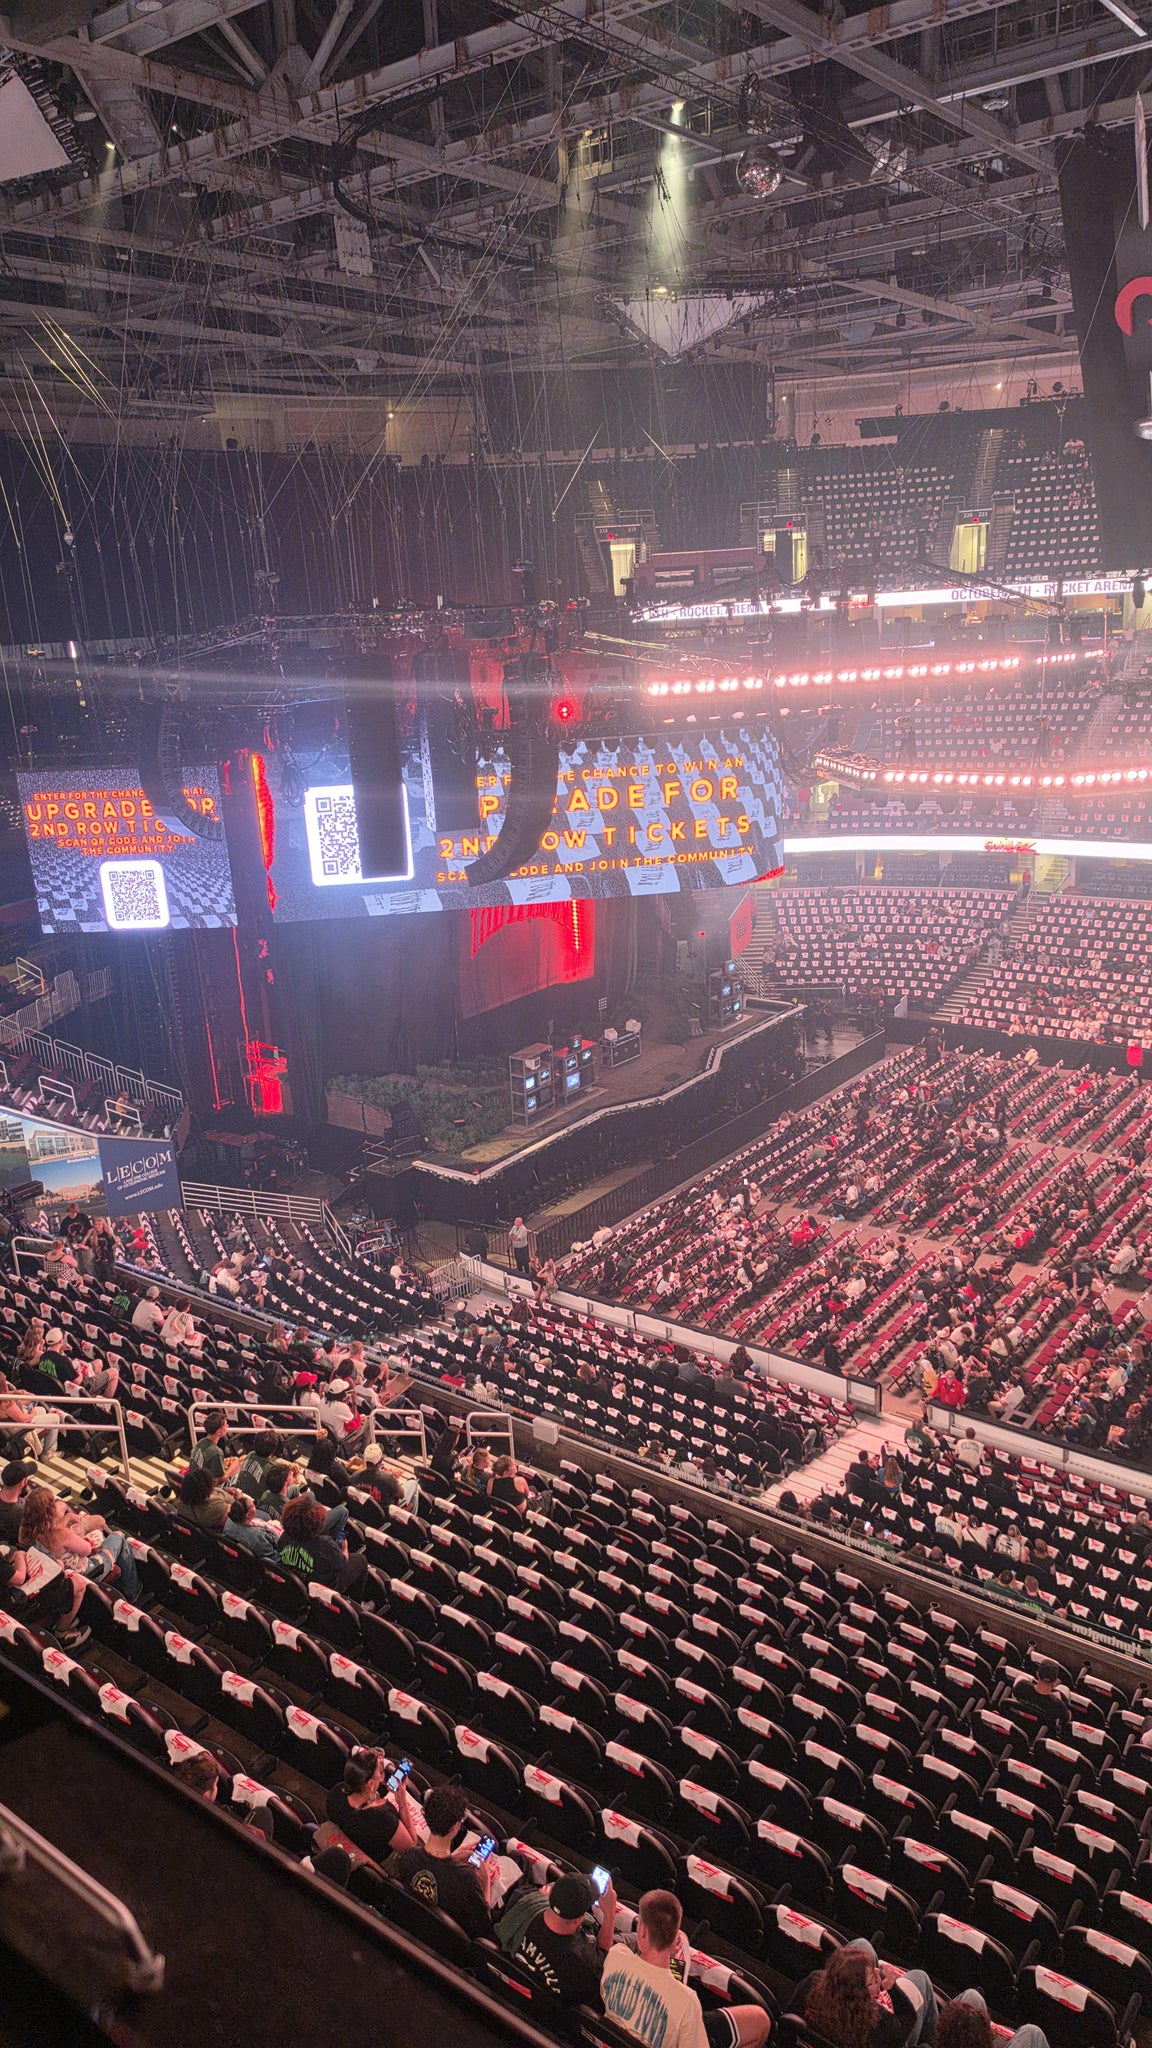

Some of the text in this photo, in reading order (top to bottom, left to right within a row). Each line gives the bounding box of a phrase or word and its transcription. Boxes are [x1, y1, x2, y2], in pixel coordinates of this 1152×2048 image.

[557, 756, 744, 781] HE CHANCE TO WIN AN
[33, 788, 145, 801] ENTER FOR THE CHANC
[663, 776, 739, 805] FOR
[26, 798, 155, 821] UPGRADE
[29, 821, 69, 838] 2ND
[75, 820, 118, 835] ROW
[57, 838, 88, 847] SCAN
[91, 837, 106, 846] QR
[108, 835, 138, 845] CODE
[141, 834, 164, 843] AND
[540, 828, 588, 851] OW
[602, 813, 752, 847] TICKETS
[82, 844, 174, 856] THE COMMUNITY
[436, 869, 468, 883] SCA
[553, 861, 584, 874] AND
[589, 856, 629, 872] JOIN
[634, 855, 662, 868] THE
[666, 845, 755, 865] COMMUNITY
